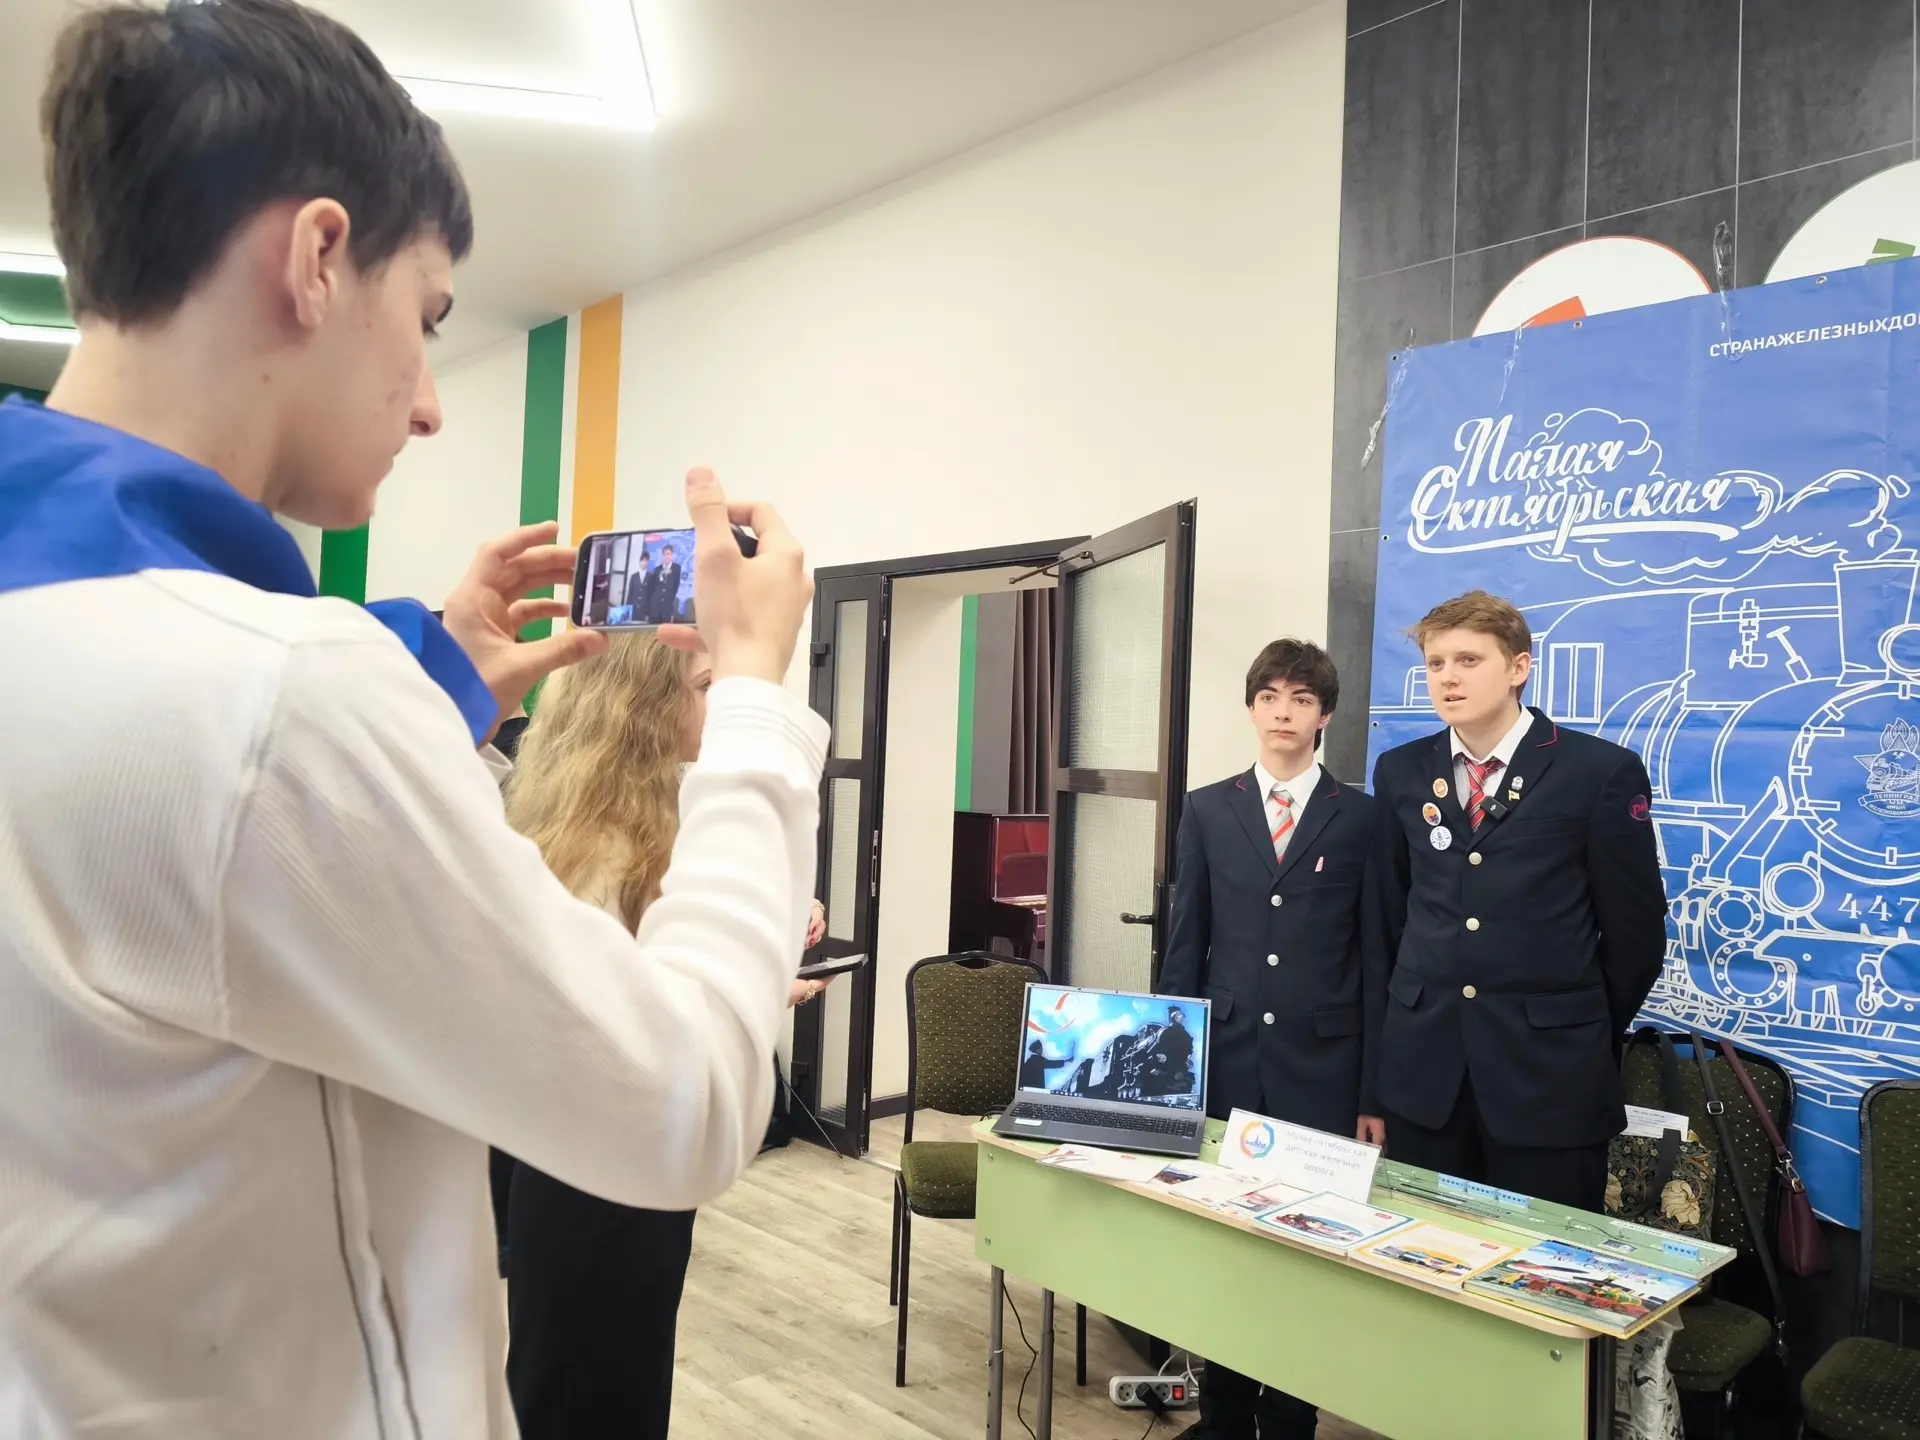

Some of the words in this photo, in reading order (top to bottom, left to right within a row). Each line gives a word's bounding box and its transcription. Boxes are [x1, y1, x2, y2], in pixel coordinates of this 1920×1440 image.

[1709, 312, 1920, 357] СТРАНАЖЕЛЕЗНЫХДО
[1454, 414, 1625, 487] Малая
[1410, 465, 1732, 556] Октябрьская
